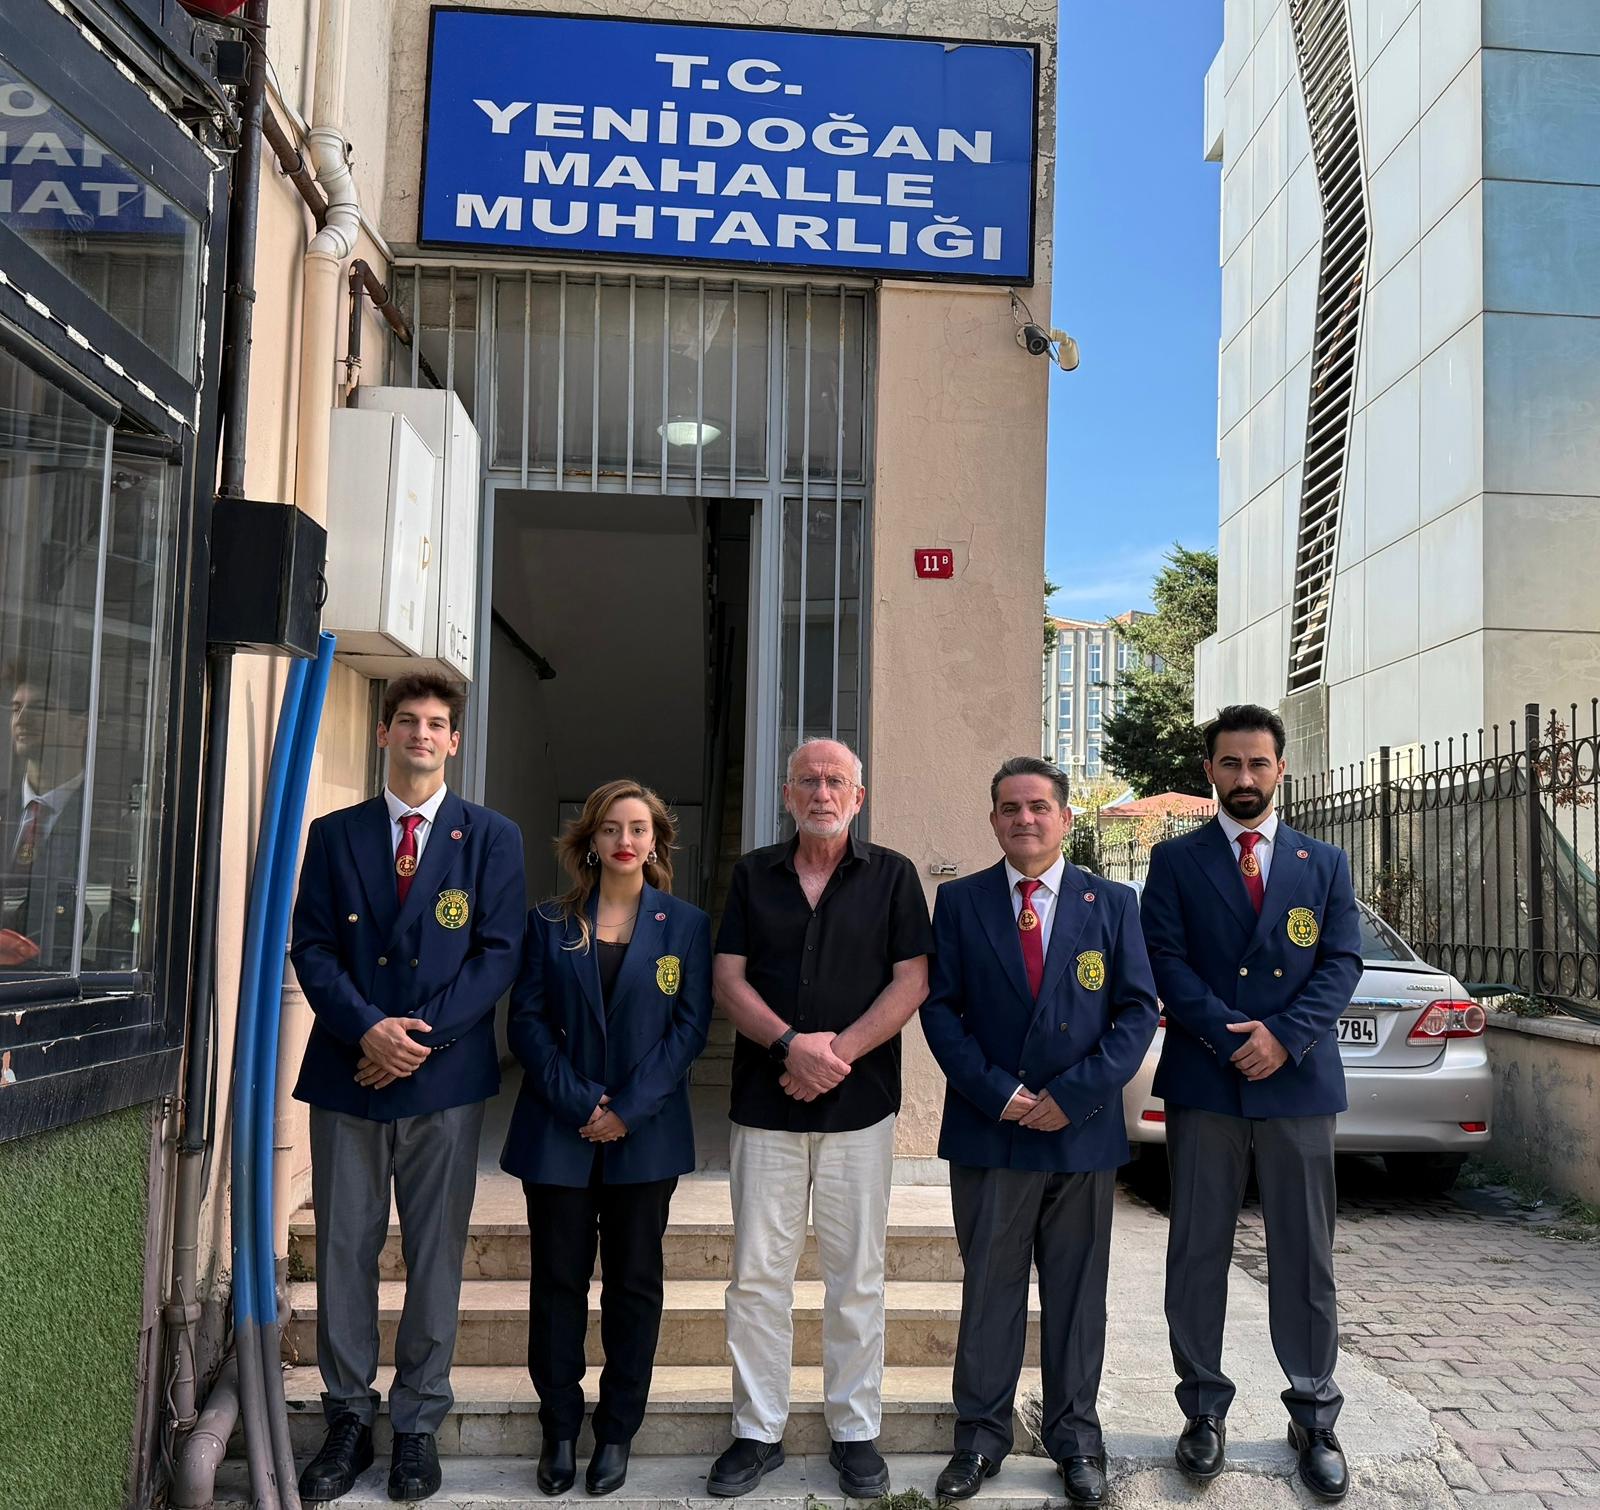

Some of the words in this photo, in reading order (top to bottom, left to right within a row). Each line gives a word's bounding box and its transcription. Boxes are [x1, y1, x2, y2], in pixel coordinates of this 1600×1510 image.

[655, 53, 803, 96] T.C.
[472, 99, 992, 164] YENİDOĞAN
[523, 150, 934, 209] MAHALLE
[455, 193, 1002, 261] MUHTARLIĞI
[923, 555, 940, 572] 11
